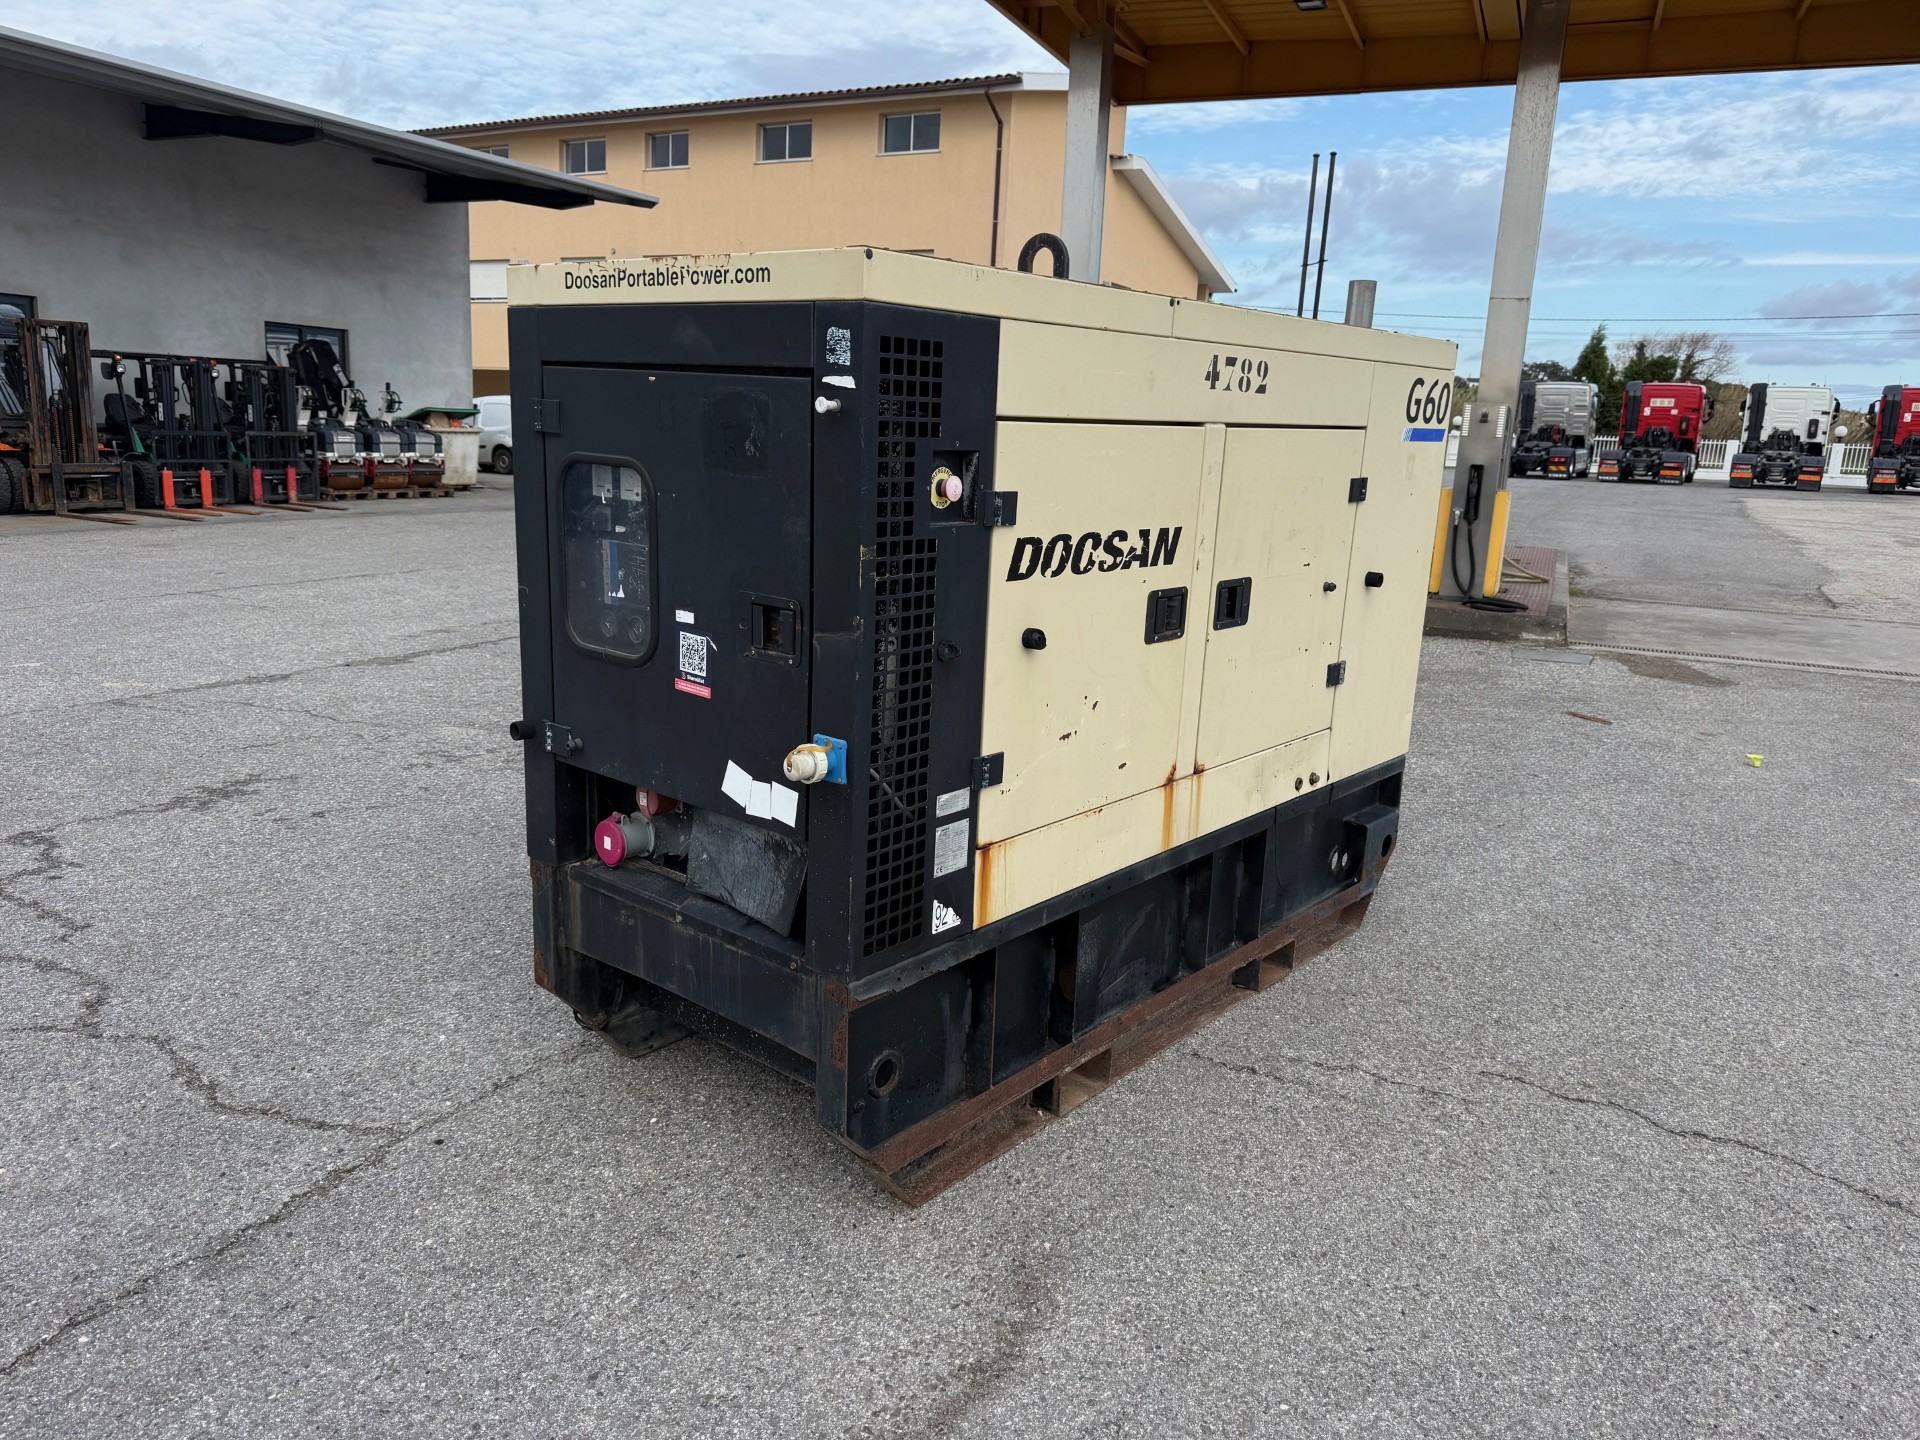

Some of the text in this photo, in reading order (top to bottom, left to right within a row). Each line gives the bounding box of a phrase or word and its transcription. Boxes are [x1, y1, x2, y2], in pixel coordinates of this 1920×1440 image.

[565, 266, 771, 290] DoosanPortablePower.com
[1204, 354, 1270, 395] 4782
[1405, 376, 1451, 425] G60
